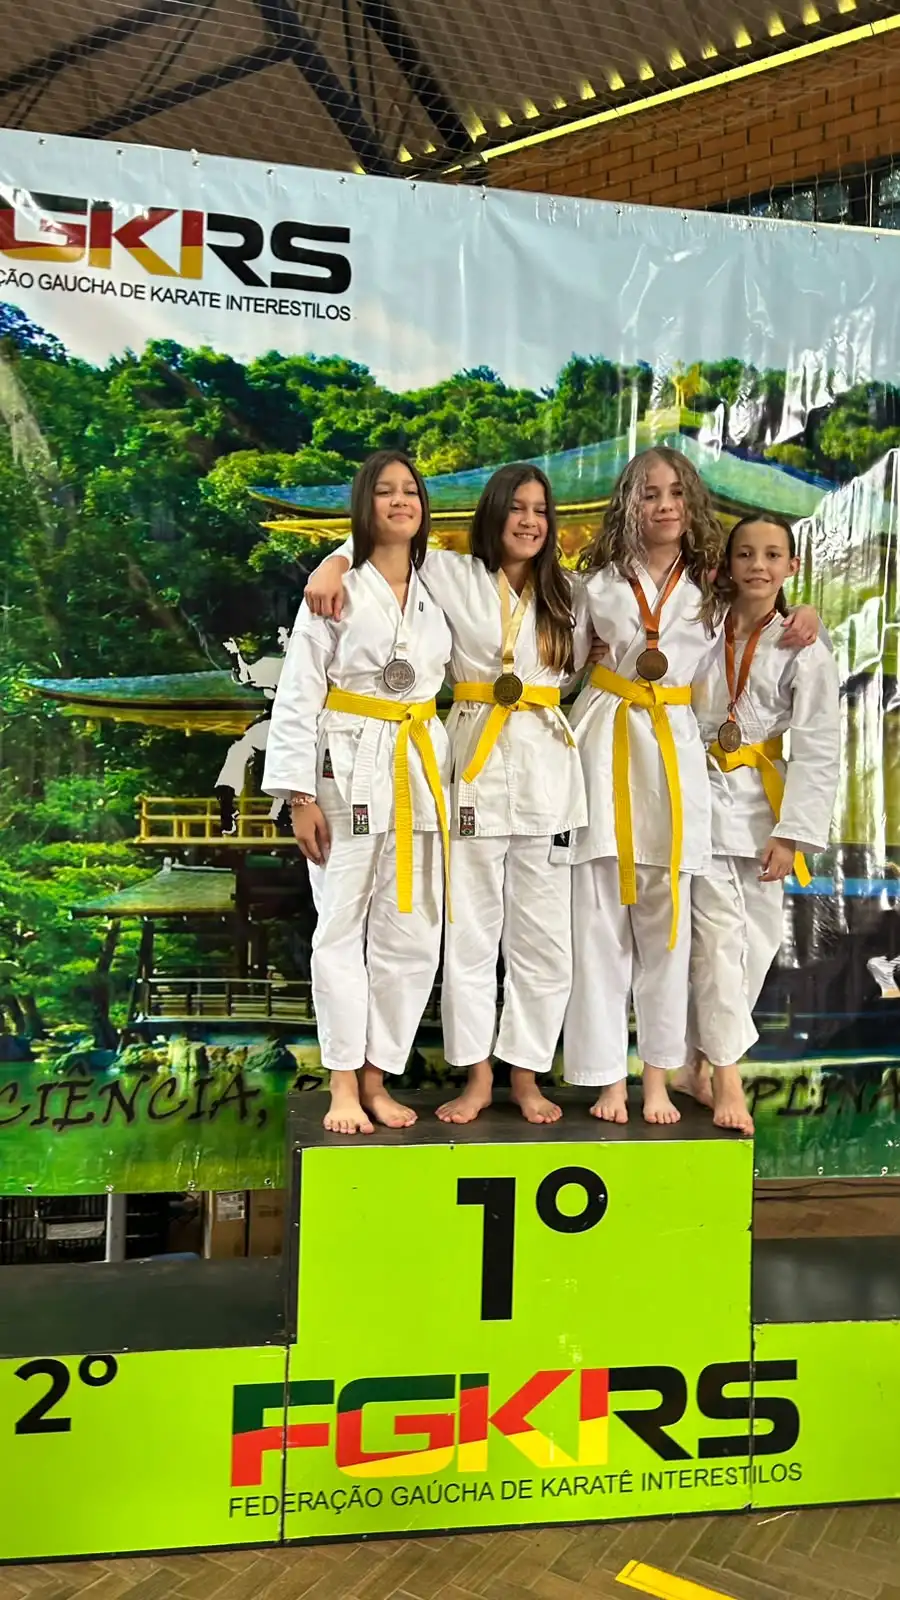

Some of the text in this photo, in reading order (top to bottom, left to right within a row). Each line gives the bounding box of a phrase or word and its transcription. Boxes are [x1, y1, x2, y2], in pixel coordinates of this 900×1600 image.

[38, 273, 118, 295] GAUCHA
[121, 281, 147, 300] DE
[151, 286, 222, 309] KARATE
[226, 294, 351, 321] INTERESTILOS
[230, 1359, 800, 1488] FGKIRS
[229, 1462, 802, 1519] FEDERAÇÃO GAÚCHA DE KARATÊ INTERESTILOS
